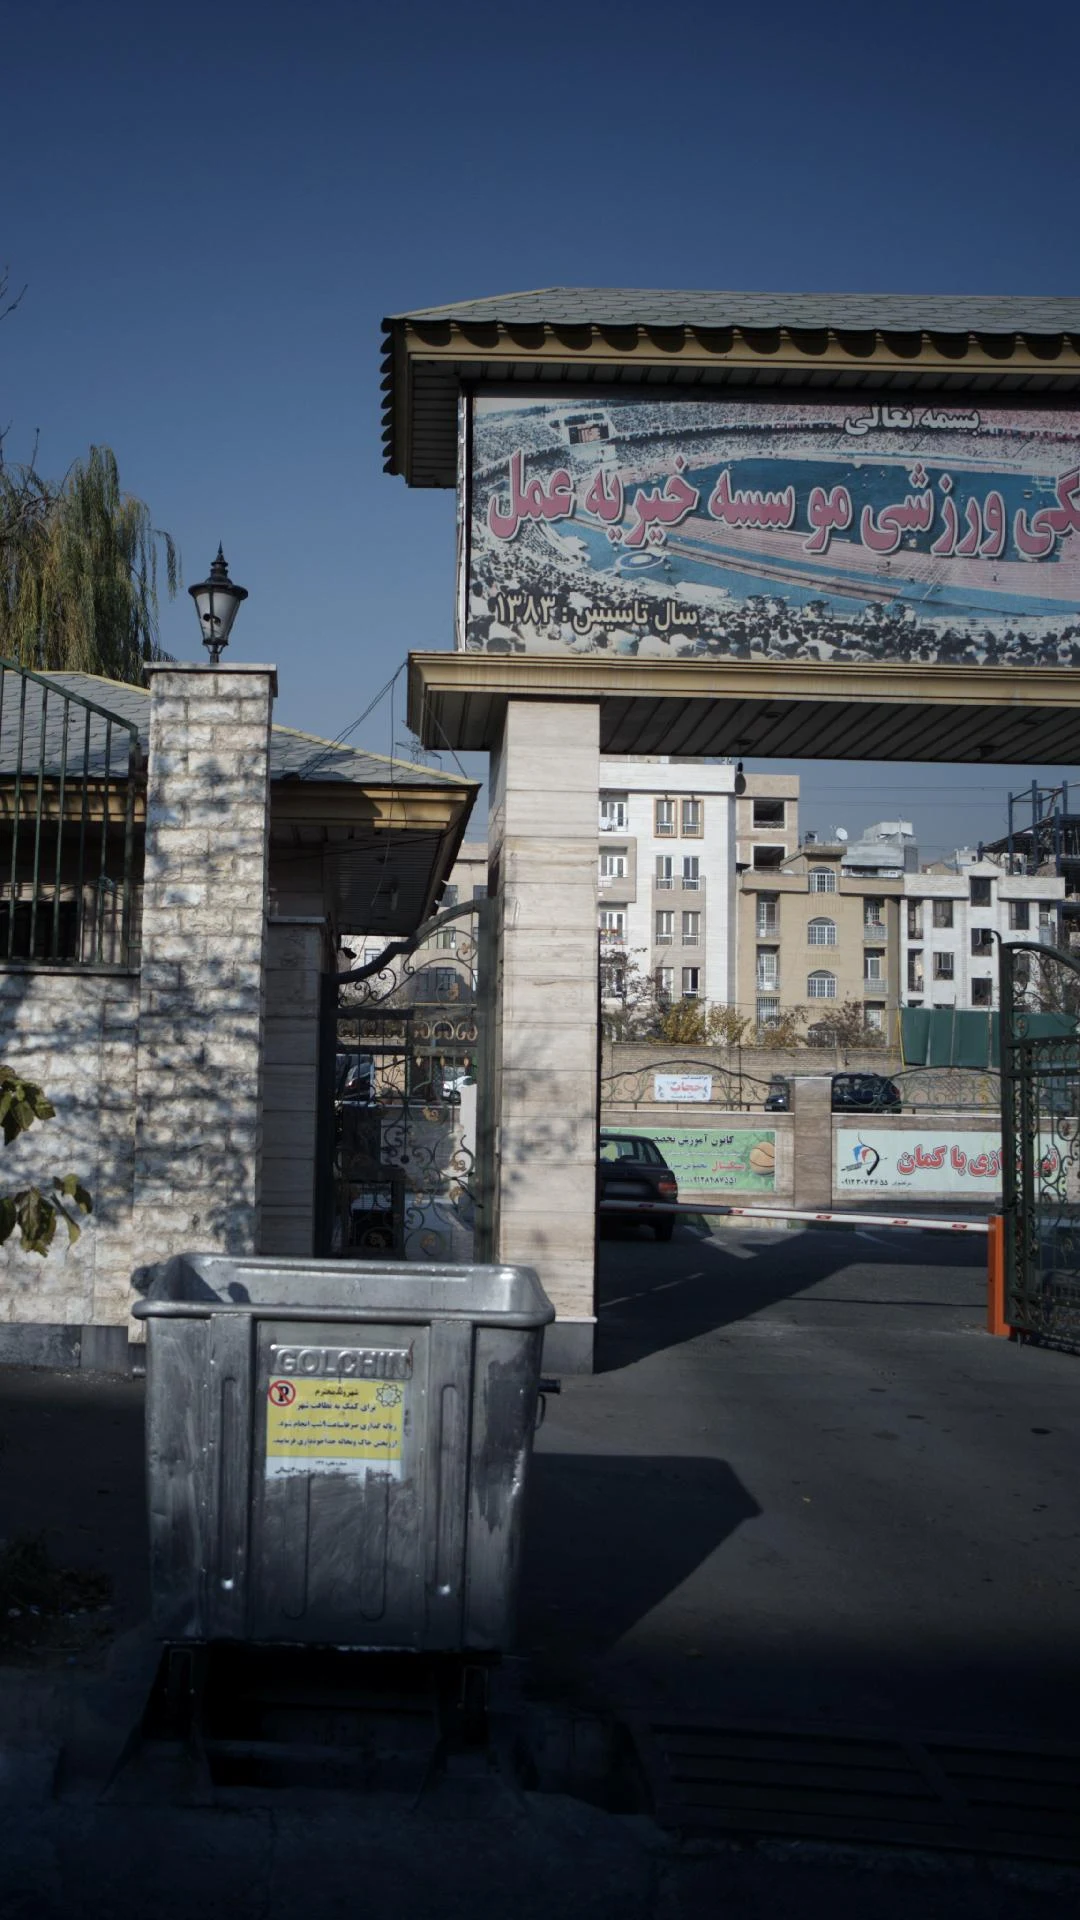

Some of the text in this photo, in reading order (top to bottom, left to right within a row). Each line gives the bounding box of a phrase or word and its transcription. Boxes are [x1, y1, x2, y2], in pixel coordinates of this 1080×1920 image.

[920, 404, 980, 437] بسمه
[487, 447, 574, 541] عمل
[860, 462, 1005, 557] ورزشی
[495, 594, 556, 625] ۱۳۸۳
[654, 599, 699, 632] سال
[897, 1144, 947, 1175] کمان
[950, 1145, 967, 1176] با
[276, 1349, 408, 1378] GOLCHIN
